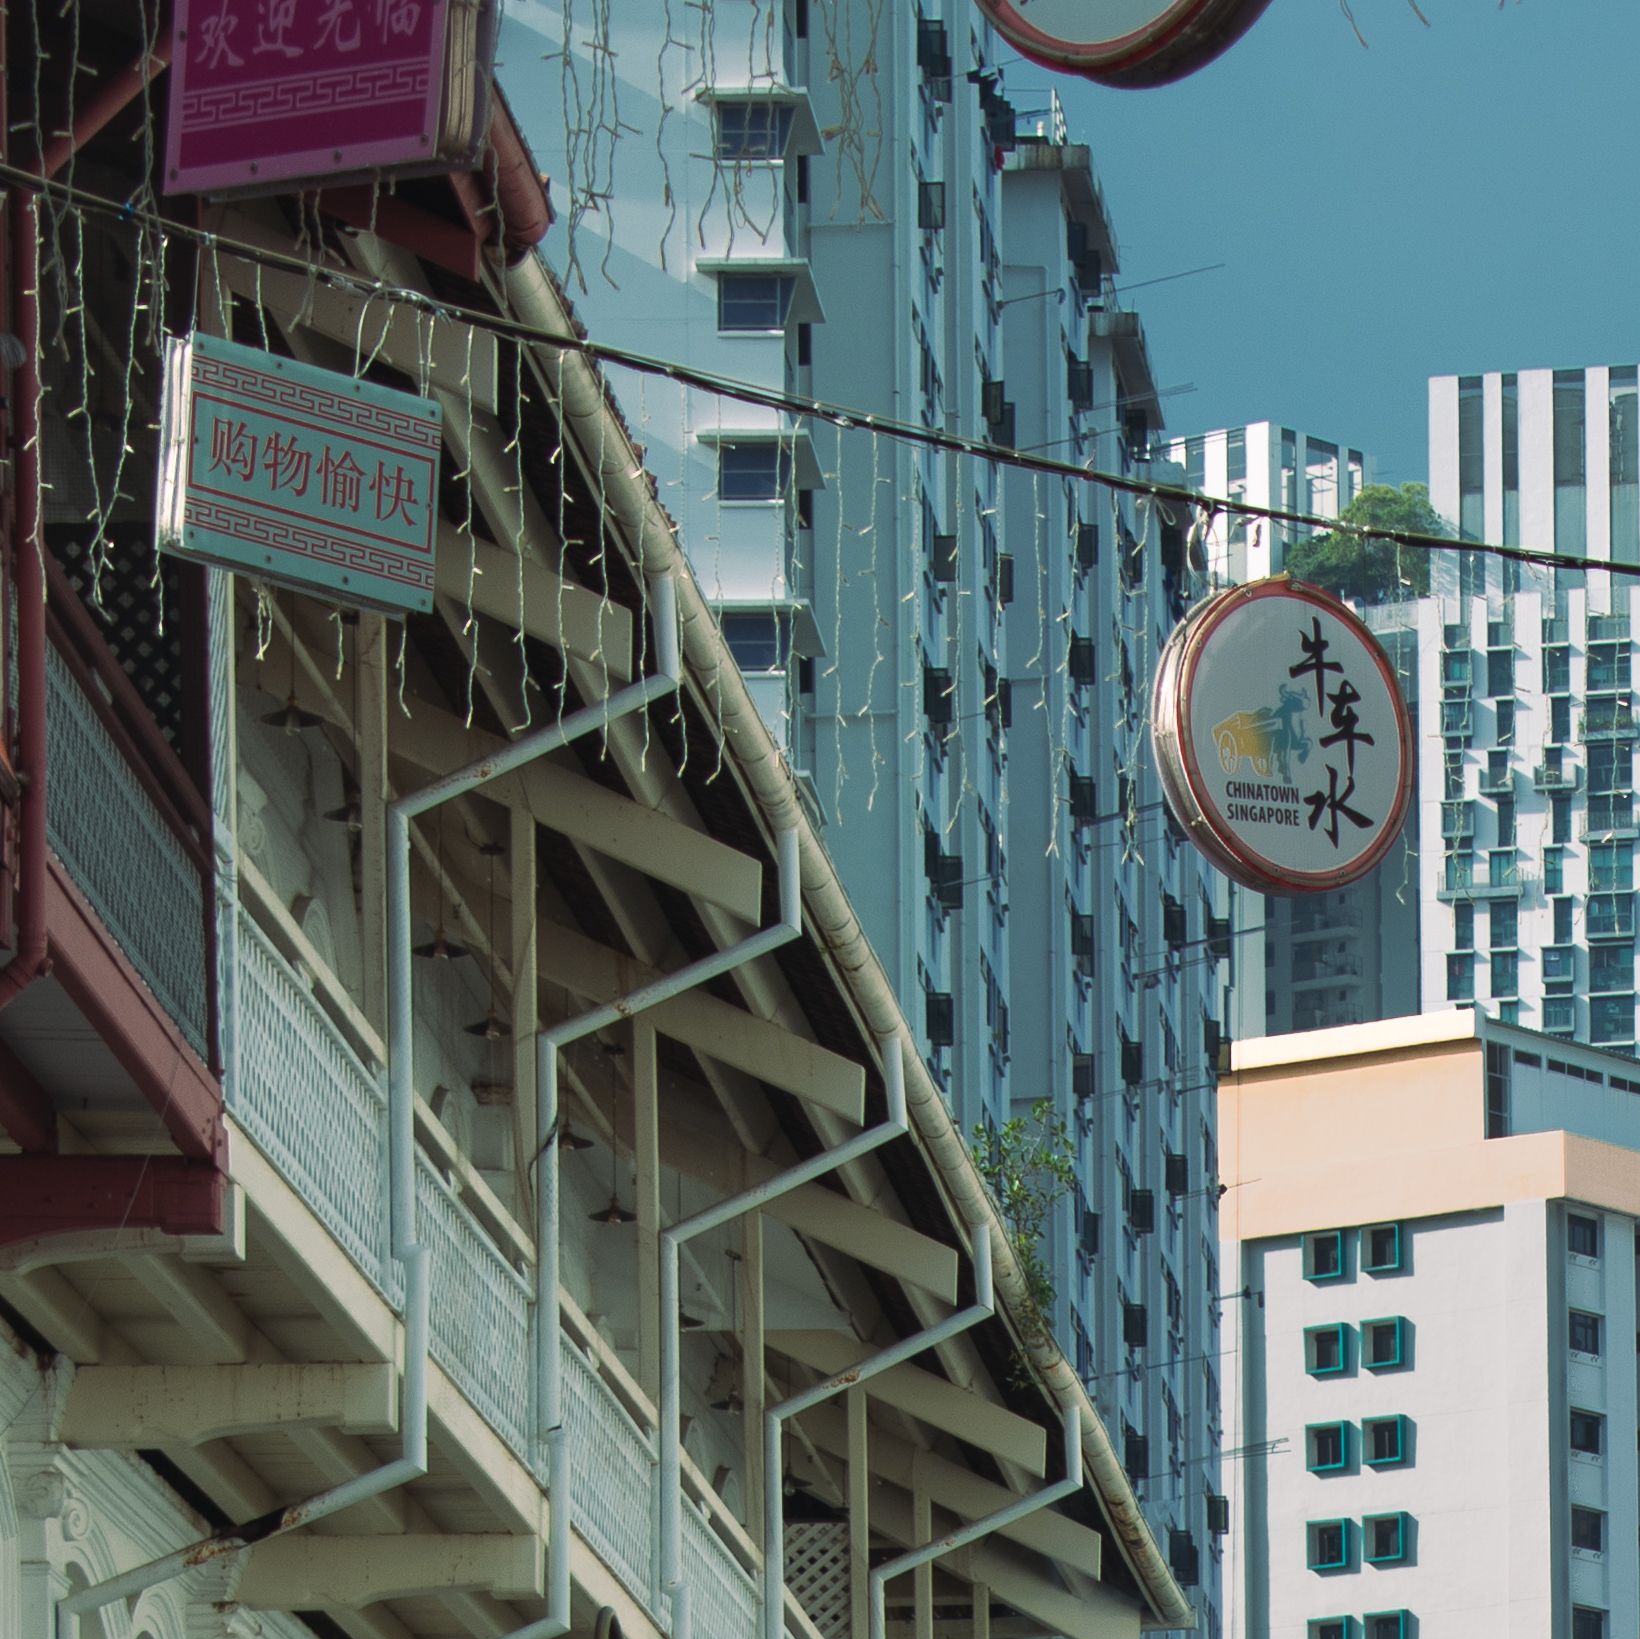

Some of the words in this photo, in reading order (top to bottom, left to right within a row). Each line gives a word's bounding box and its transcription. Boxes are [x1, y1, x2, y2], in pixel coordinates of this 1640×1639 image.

[208, 416, 419, 526] 购物愉快
[1289, 616, 1375, 849] 牛车水
[1226, 781, 1300, 804] CHINATOWN
[1227, 804, 1300, 826] SINGAPORE
